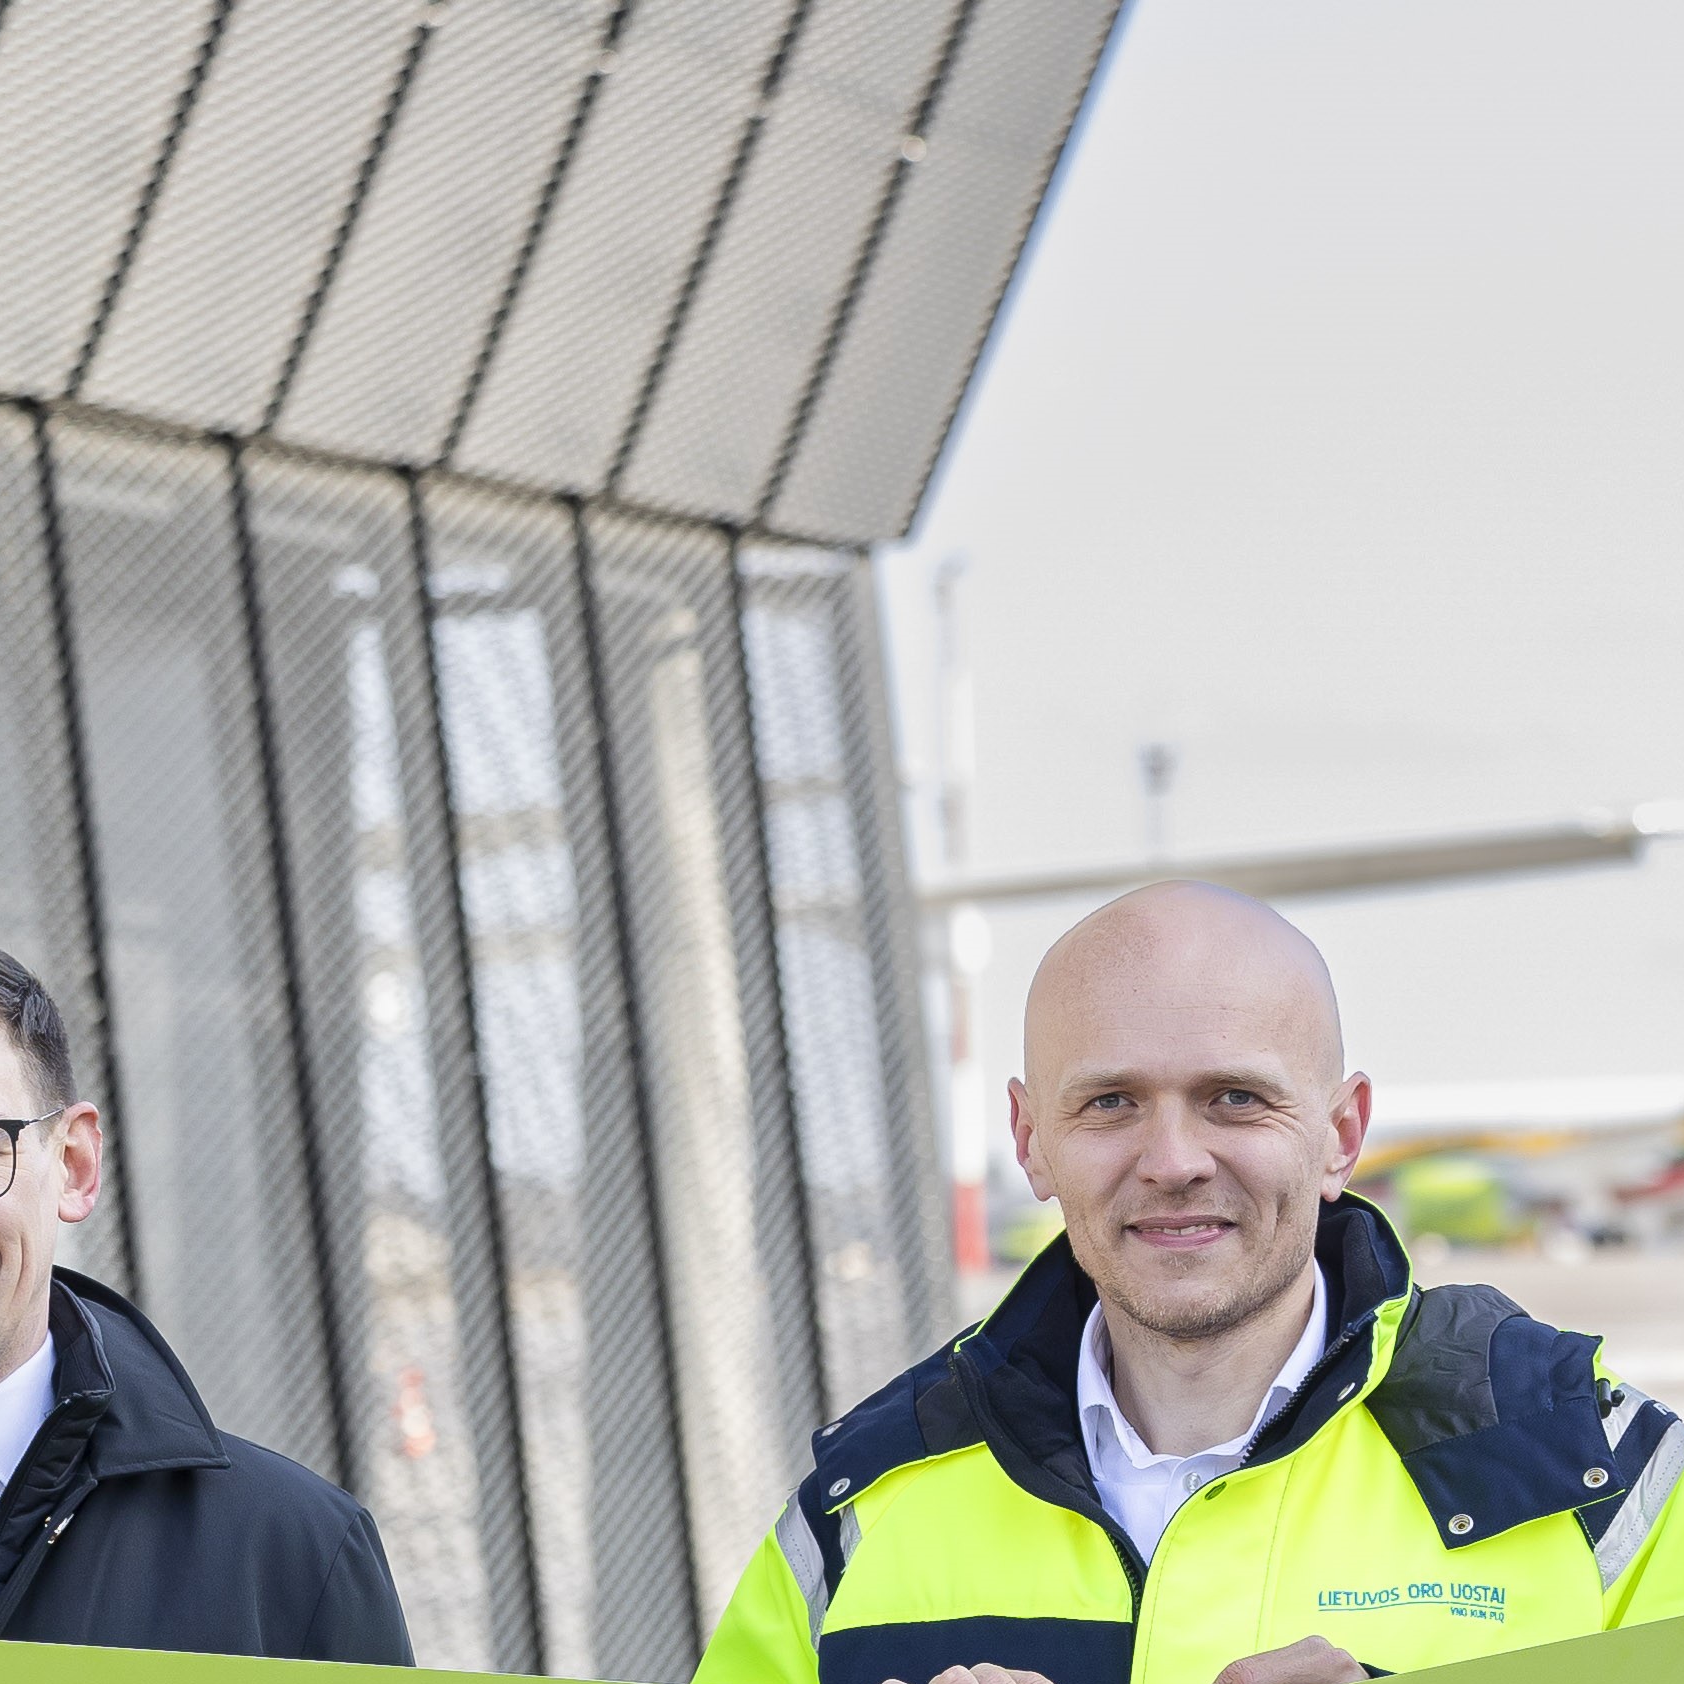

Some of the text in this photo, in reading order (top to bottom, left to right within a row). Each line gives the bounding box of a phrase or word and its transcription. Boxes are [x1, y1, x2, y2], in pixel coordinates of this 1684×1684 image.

[1318, 1583, 1505, 1606] LIETUVOS ORO UOSTAI
